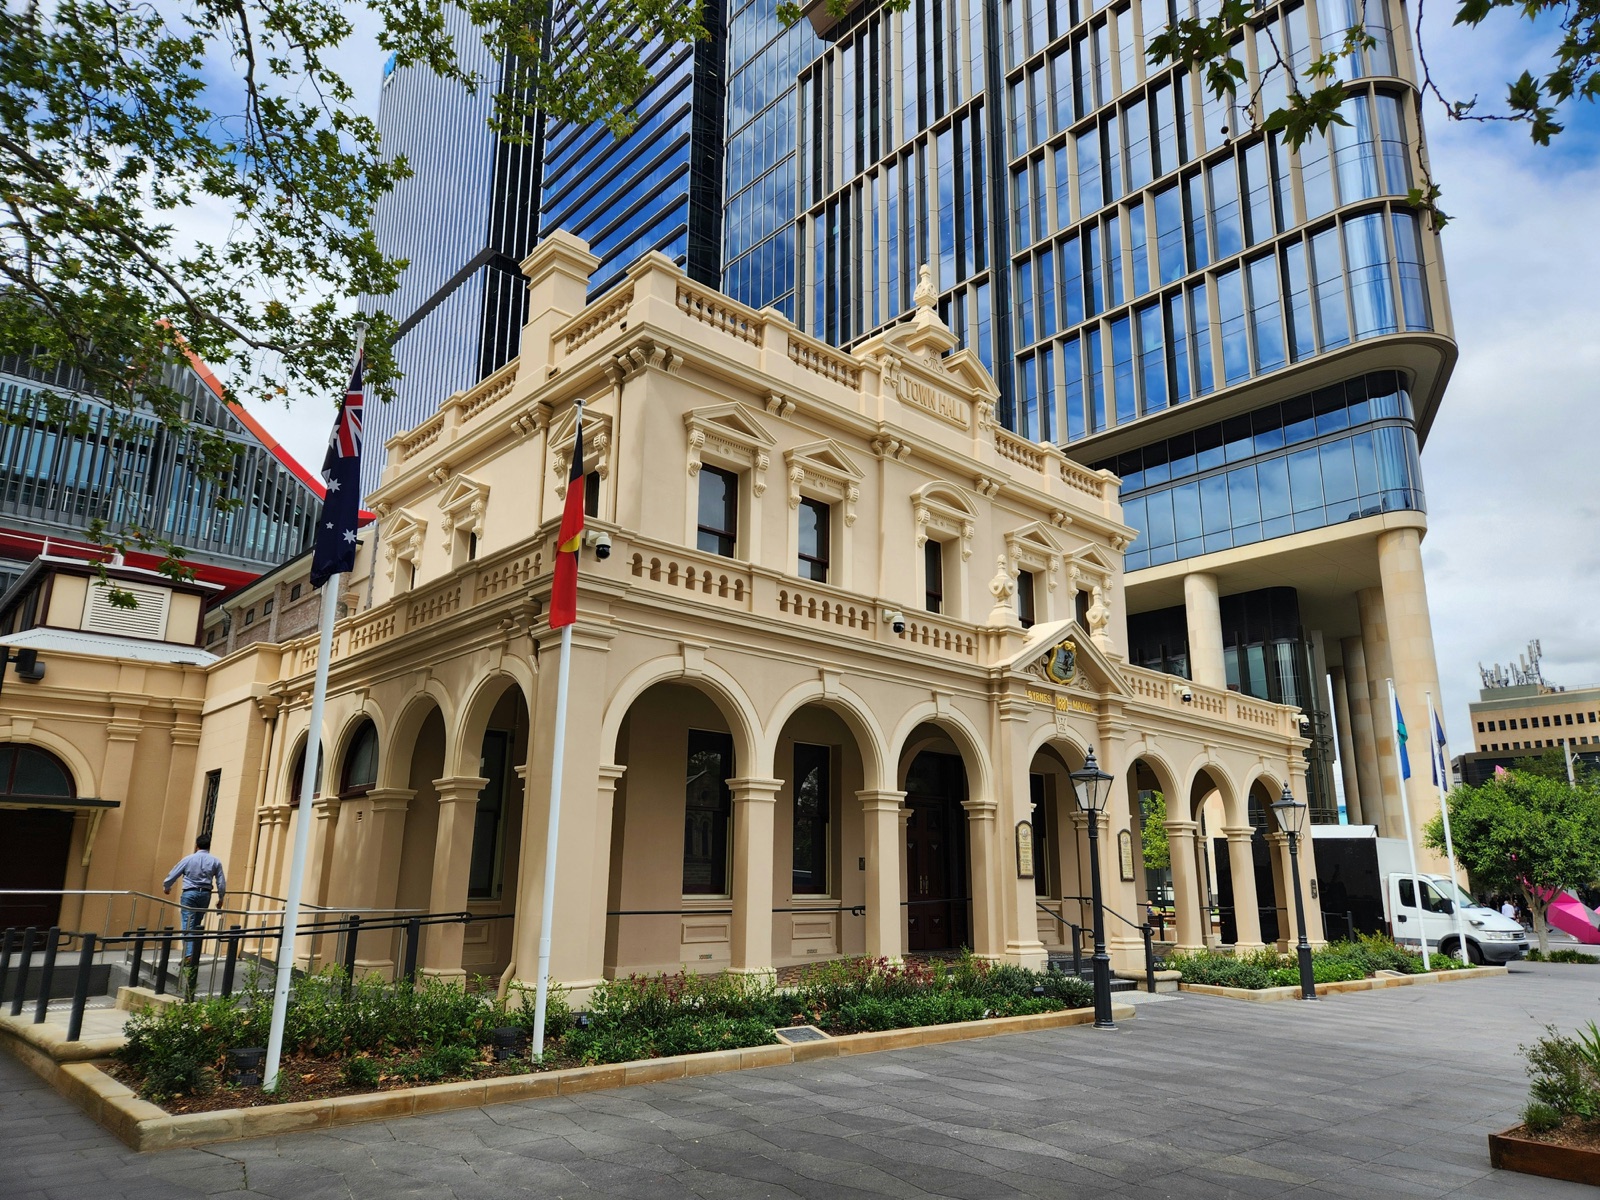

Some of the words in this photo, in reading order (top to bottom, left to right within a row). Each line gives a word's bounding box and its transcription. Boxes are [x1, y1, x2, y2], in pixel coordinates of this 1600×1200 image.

[904, 376, 936, 411] TOWN
[938, 393, 967, 425] HALL
[1072, 700, 1093, 713] MAYOR
